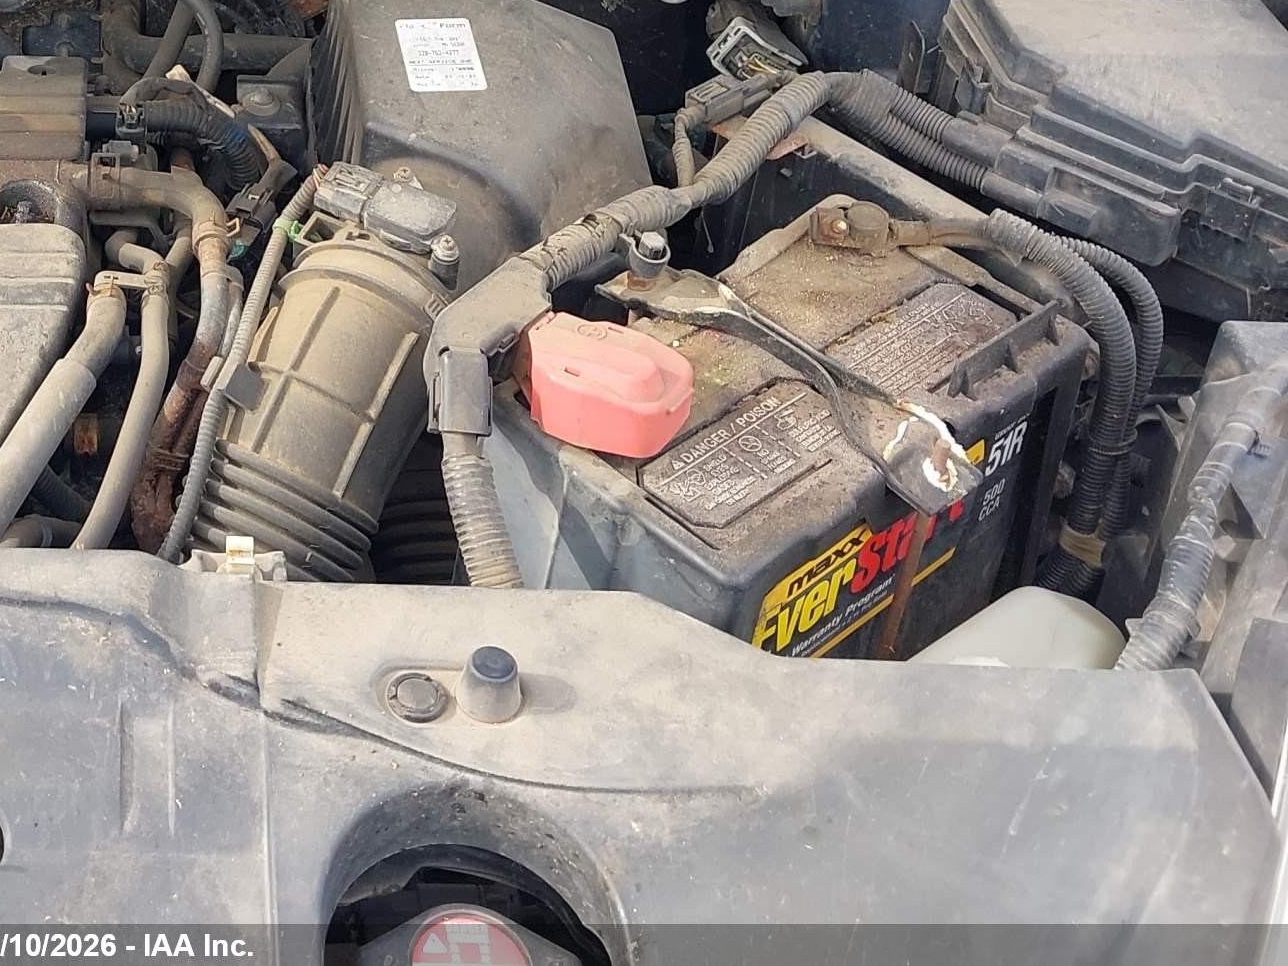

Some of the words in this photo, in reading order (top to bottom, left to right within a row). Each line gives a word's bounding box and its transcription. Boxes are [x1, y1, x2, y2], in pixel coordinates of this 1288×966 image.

[682, 429, 731, 465] DANGER
[736, 396, 783, 429] POISON
[984, 420, 1028, 478] 51R
[978, 495, 1001, 522] CCA
[982, 477, 1006, 506] 500
[786, 528, 868, 598] maxx
[791, 614, 844, 658] Warranty
[844, 575, 894, 620] Program
